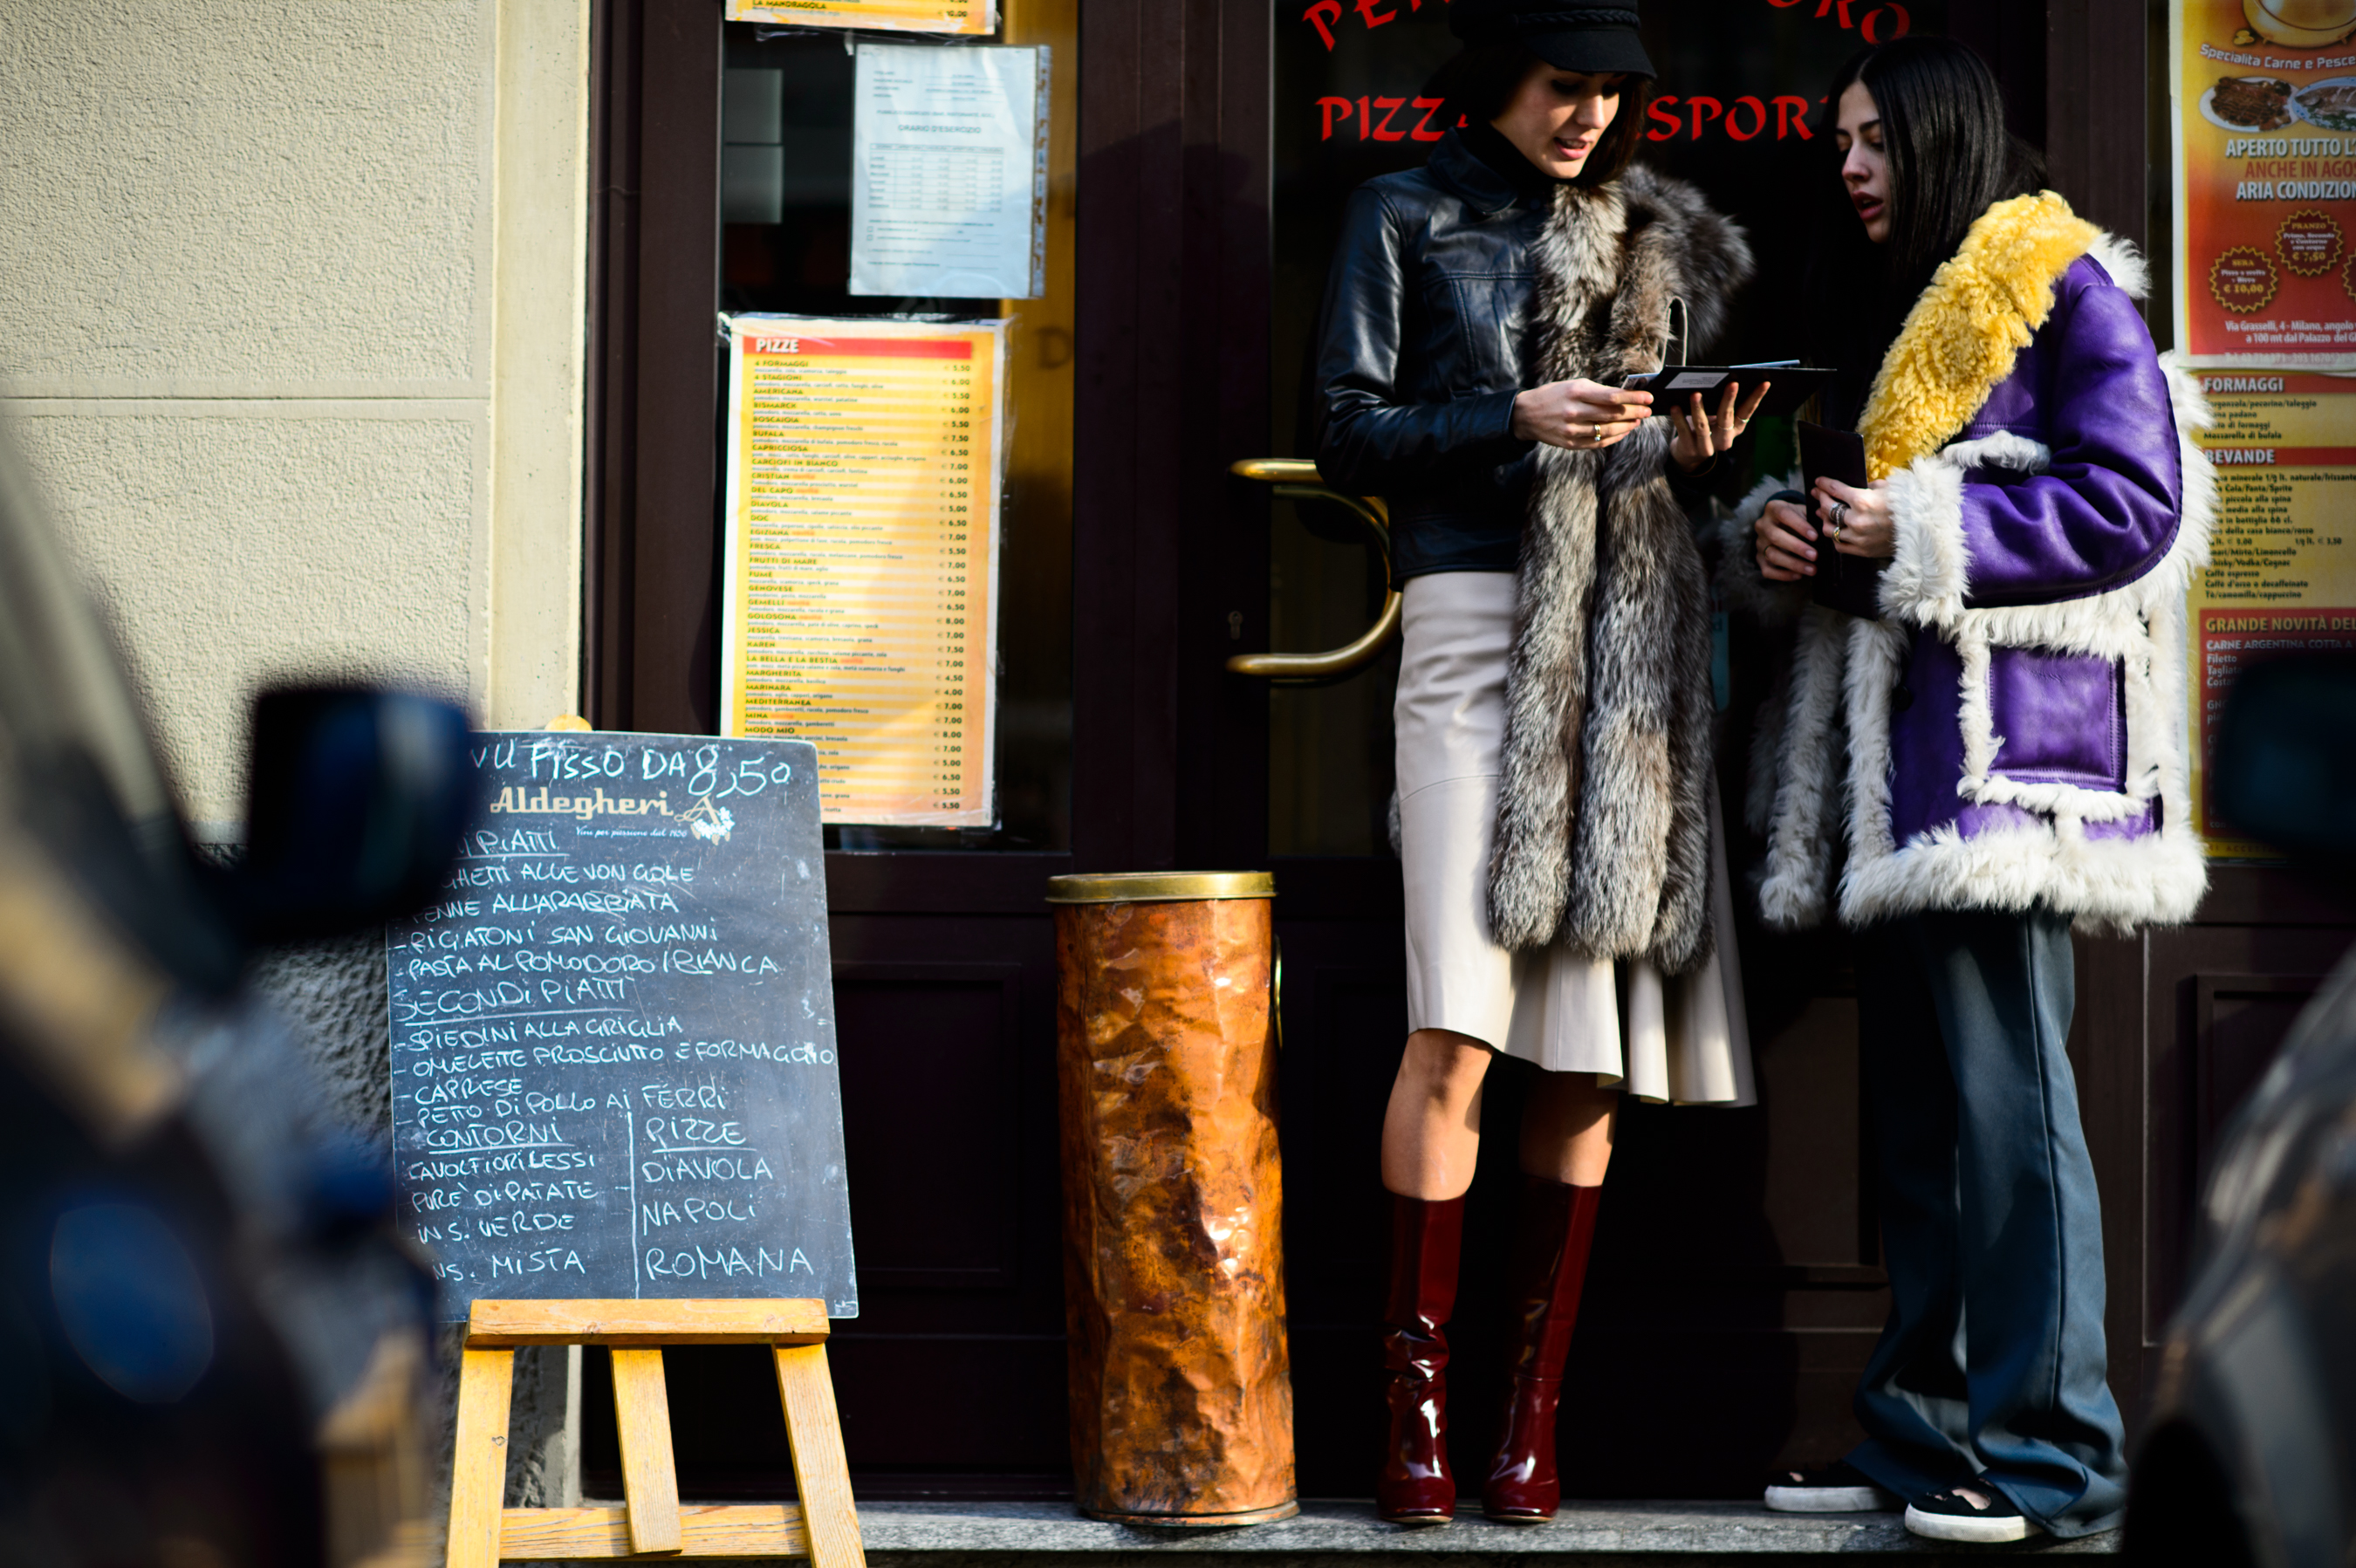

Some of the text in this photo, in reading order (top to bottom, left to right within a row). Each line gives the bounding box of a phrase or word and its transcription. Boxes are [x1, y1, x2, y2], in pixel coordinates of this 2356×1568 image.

[2200, 44, 2356, 70] Specialità Carne e Pesce
[1314, 95, 1469, 141] PIZZ
[2225, 138, 2341, 157] APERTO TUTTO
[2245, 161, 2297, 178] ANCHE
[2301, 161, 2318, 178] IN
[2236, 181, 2274, 200] ARIA
[2303, 251, 2326, 262] 7,50
[2234, 284, 2264, 295] 10,00
[2225, 320, 2239, 332] Via
[2279, 320, 2285, 331] 4
[2291, 320, 2323, 332] Milano,
[2324, 320, 2354, 334] angolo
[2254, 332, 2347, 343] 100 dal Palazzo del
[756, 338, 799, 353] PIZZE
[2204, 377, 2284, 392] FORMAGGI
[2229, 409, 2257, 421] padano
[2238, 421, 2270, 430] formaggi
[2258, 430, 2282, 439] bufala
[2205, 448, 2275, 464] BEVANDE
[2230, 473, 2263, 482] minerale
[2225, 483, 2292, 495] Cola/Fanta/Sprite
[2226, 495, 2252, 505] piccola
[2236, 516, 2267, 526] bottiglia
[2261, 579, 2308, 588] decaffeinato
[2206, 617, 2268, 631] GRANDE
[2271, 614, 2327, 631] NOVITÀ
[2206, 639, 2342, 650] CARNE ARGENTINA COTTA
[2207, 654, 2236, 664] Filetto
[642, 749, 686, 780] DA
[688, 744, 791, 798] 8,50
[490, 786, 674, 820] Aldegheri
[547, 925, 593, 945] SAN
[409, 955, 473, 981] PASTA
[477, 955, 513, 971] AL
[414, 1078, 523, 1105] CAPRESE
[505, 1181, 599, 1202] PATATE
[479, 1210, 576, 1237] VERDE
[646, 1245, 814, 1280] ROMANA
